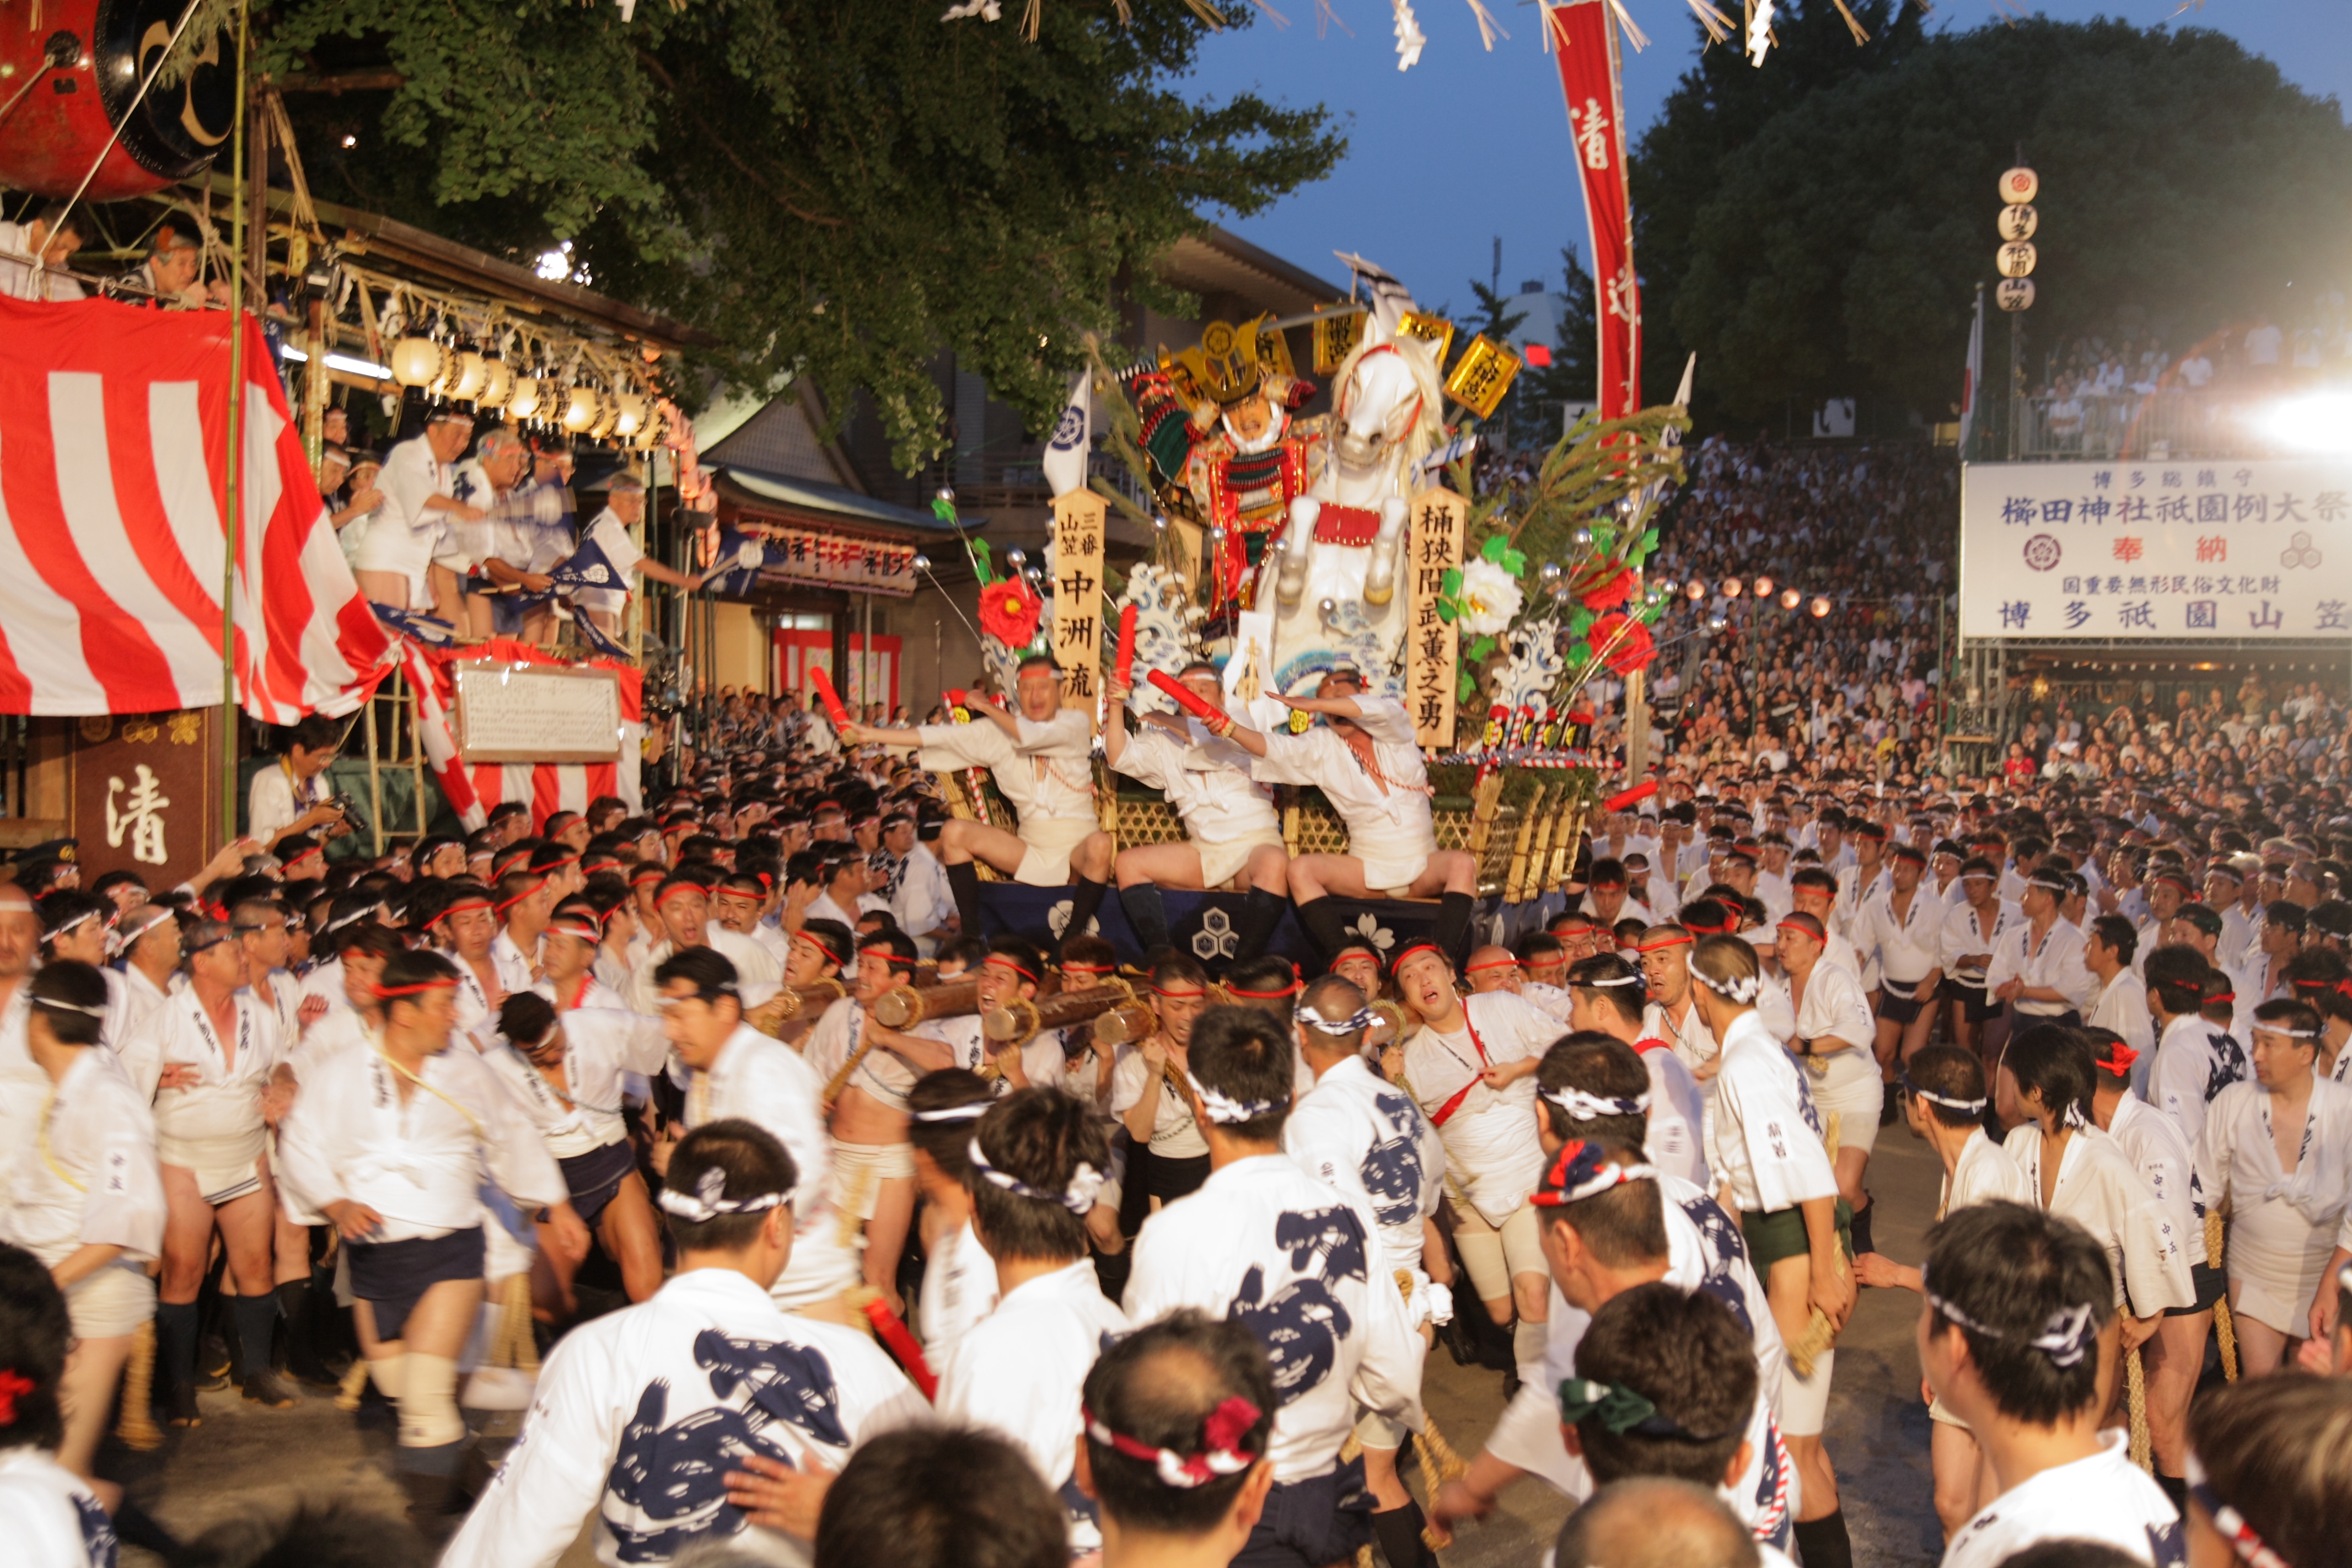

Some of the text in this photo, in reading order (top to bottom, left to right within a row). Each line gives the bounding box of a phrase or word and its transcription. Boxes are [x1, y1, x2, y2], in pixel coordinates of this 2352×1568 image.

[2001, 492, 2351, 525] 櫛田神社祇園例大祭
[1060, 513, 1079, 557] 山笠
[1081, 512, 1099, 557] 三番
[2113, 535, 2228, 564] 奉納
[2063, 576, 2282, 595] 国重要無形民俗文化財
[1997, 599, 2351, 630] 博多祇園山笠
[1060, 570, 1096, 699] 中洲流
[106, 764, 170, 866] 清
